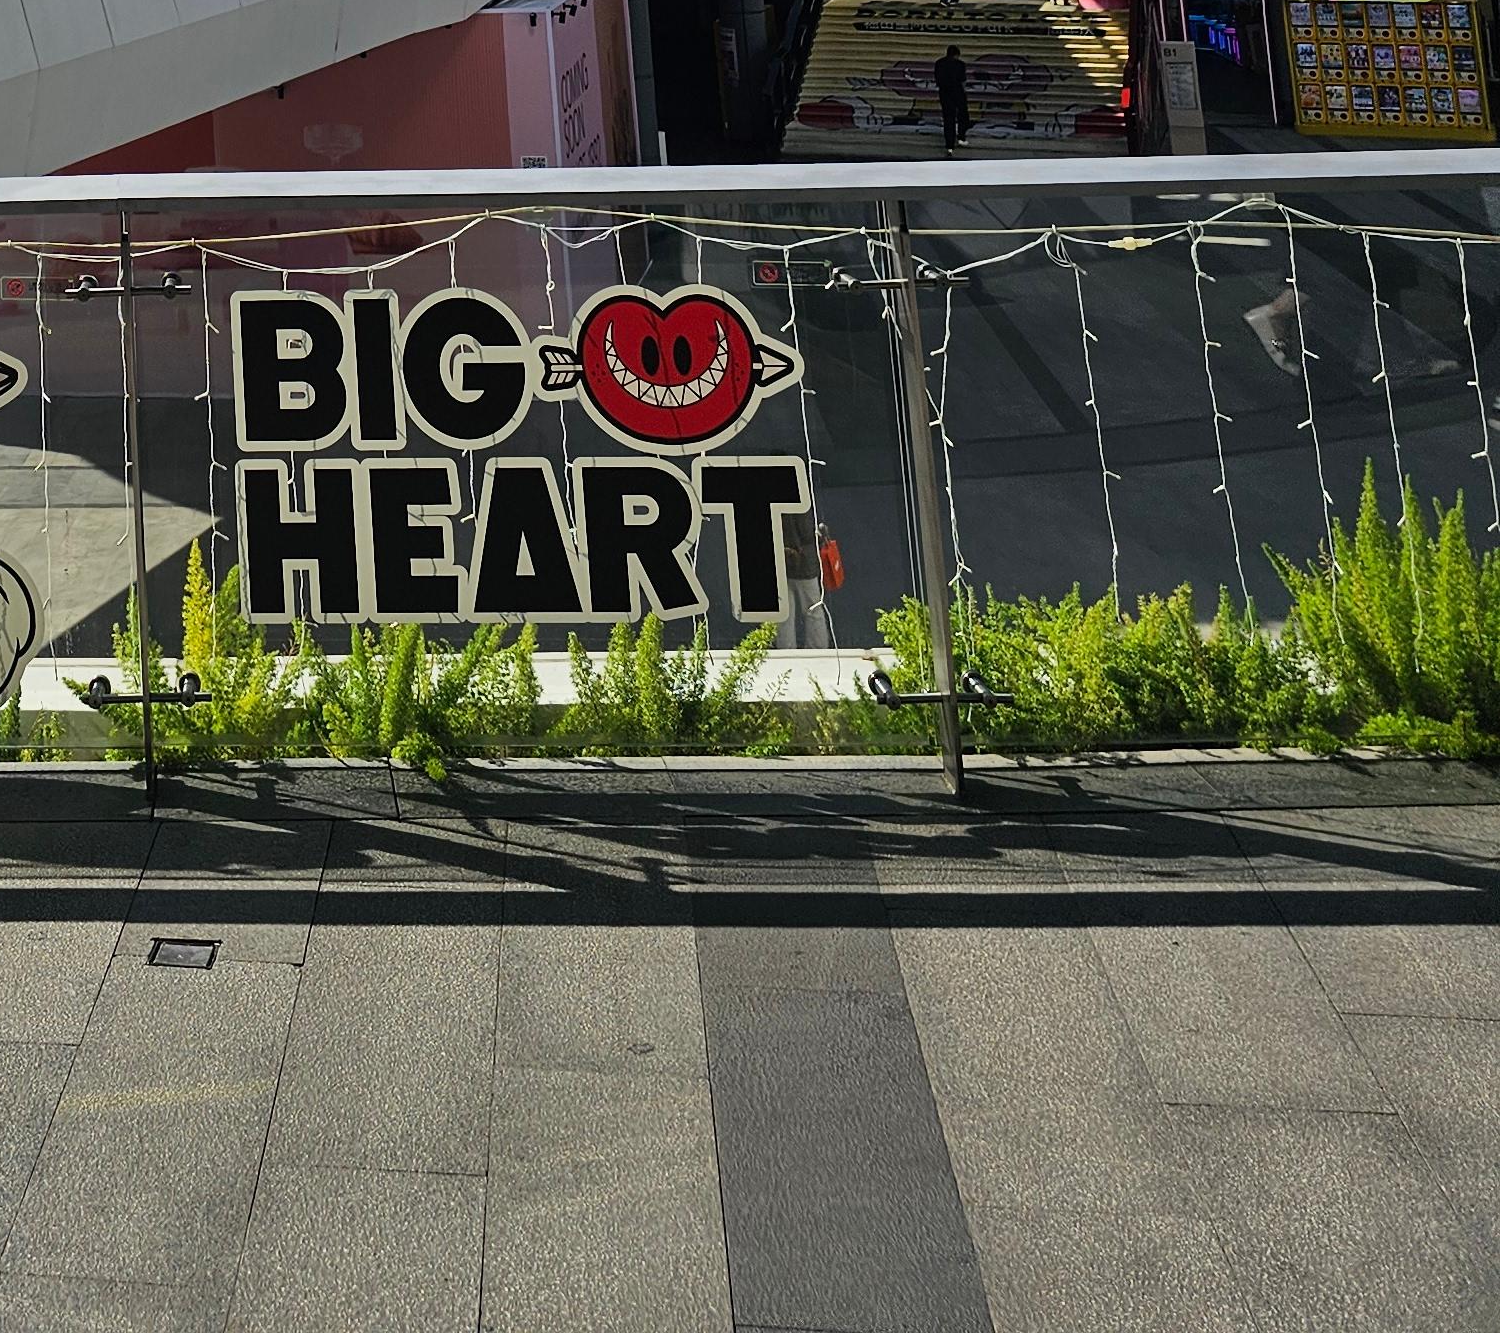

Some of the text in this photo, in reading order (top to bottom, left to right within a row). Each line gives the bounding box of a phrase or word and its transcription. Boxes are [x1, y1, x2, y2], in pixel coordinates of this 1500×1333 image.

[560, 52, 589, 113] COMING
[564, 102, 586, 159] SOON
[239, 296, 526, 441] BIG
[244, 465, 803, 615] HEART
